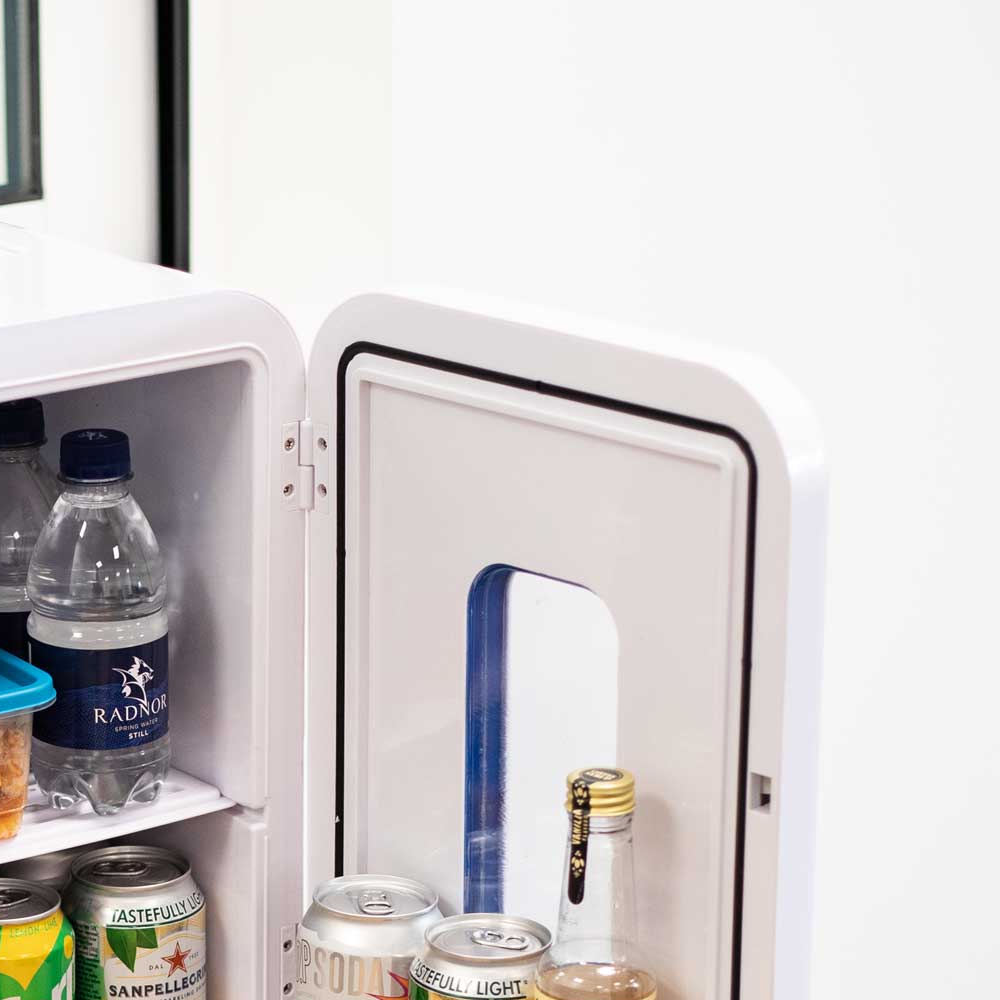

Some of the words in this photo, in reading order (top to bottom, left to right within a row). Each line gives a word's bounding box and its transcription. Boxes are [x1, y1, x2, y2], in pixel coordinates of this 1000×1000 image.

[94, 693, 167, 724] RADNOR
[114, 723, 139, 733] SPRING
[128, 729, 149, 740] STILL
[111, 900, 187, 923] TASTEFULLY
[313, 947, 385, 997] SODA
